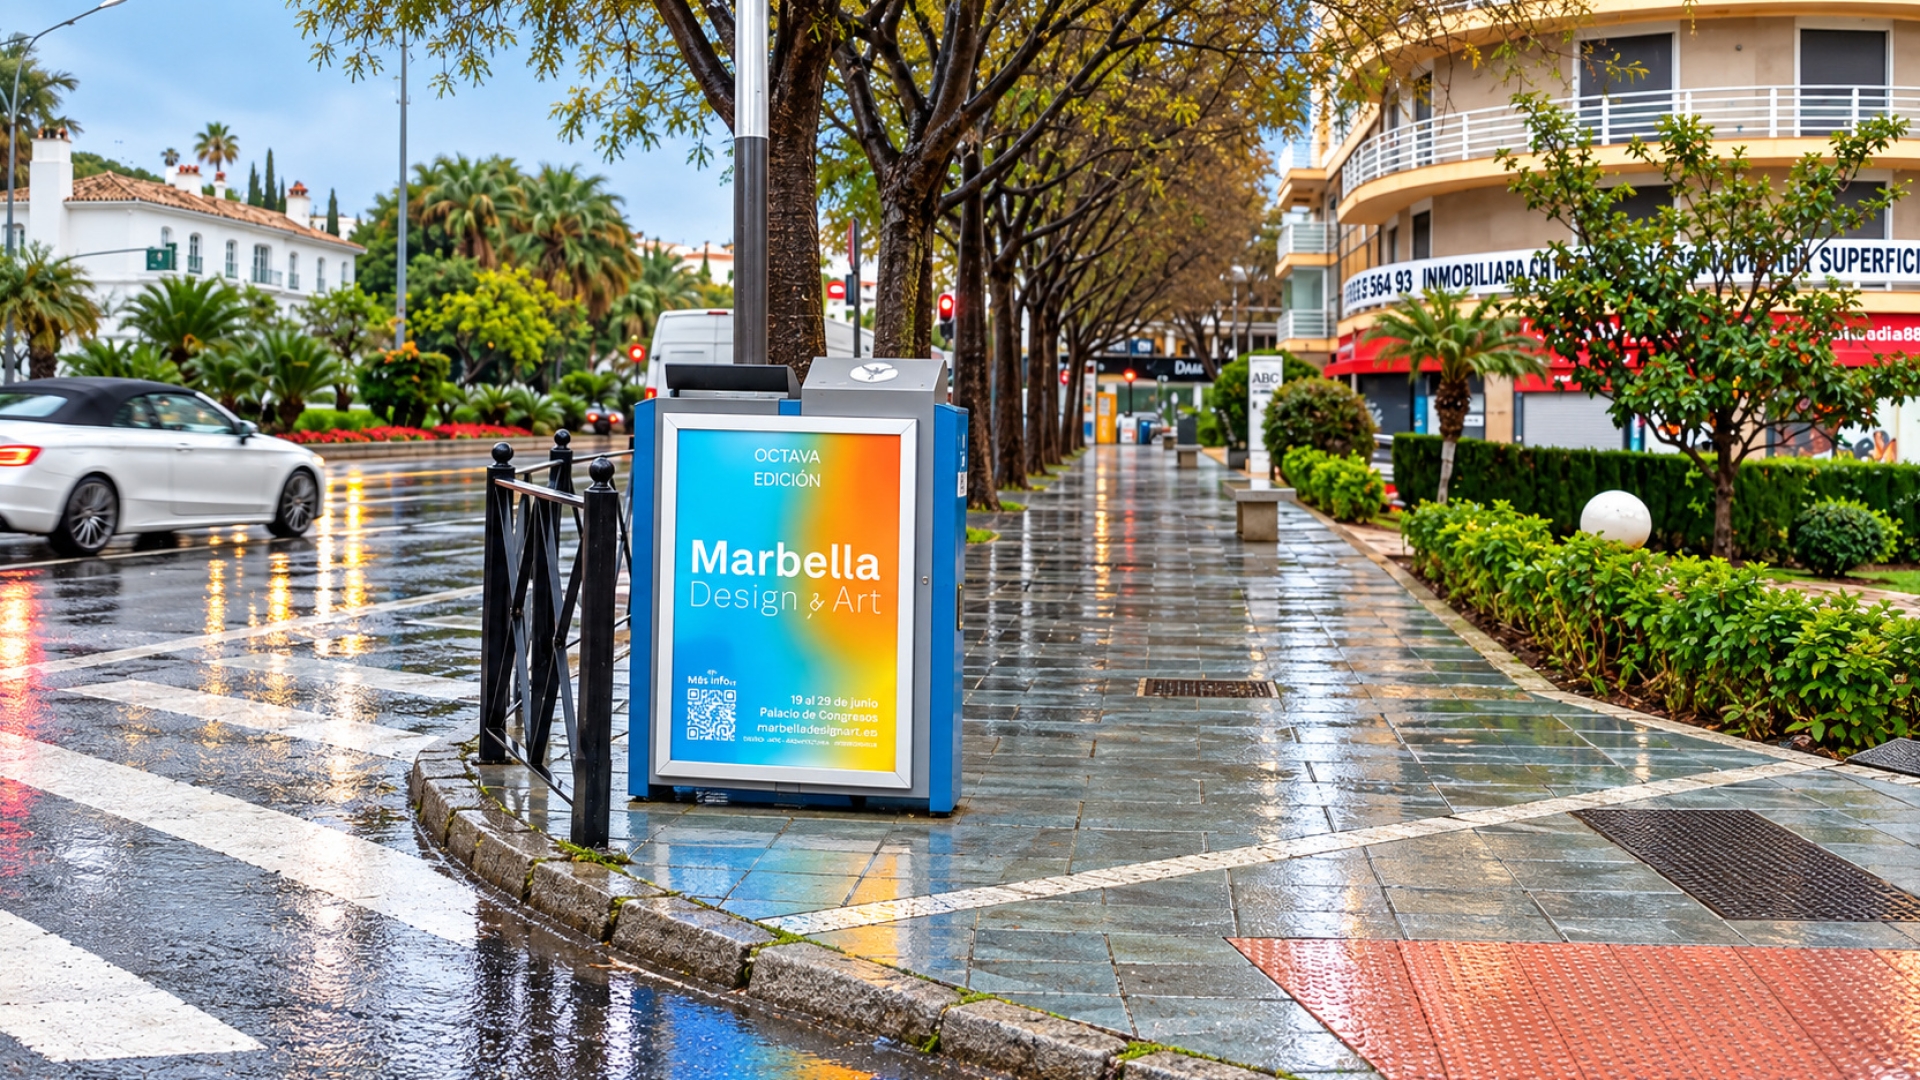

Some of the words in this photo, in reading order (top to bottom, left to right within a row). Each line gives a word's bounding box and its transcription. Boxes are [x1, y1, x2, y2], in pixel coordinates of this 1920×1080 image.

[1369, 272, 1392, 298] 564
[1395, 269, 1413, 293] 93
[1252, 372, 1280, 384] ABC
[754, 448, 821, 464] OCTAVA
[754, 469, 821, 488] EDICIÓN
[691, 539, 881, 581] Marbella
[690, 580, 798, 617] Design
[832, 585, 882, 615] Art
[790, 694, 803, 706] 19
[804, 694, 816, 706] al
[817, 695, 832, 706] 29
[833, 696, 848, 707] de
[849, 697, 879, 710] junio
[760, 707, 800, 719] Palacio
[802, 709, 817, 720] de
[818, 710, 879, 723] Congresos
